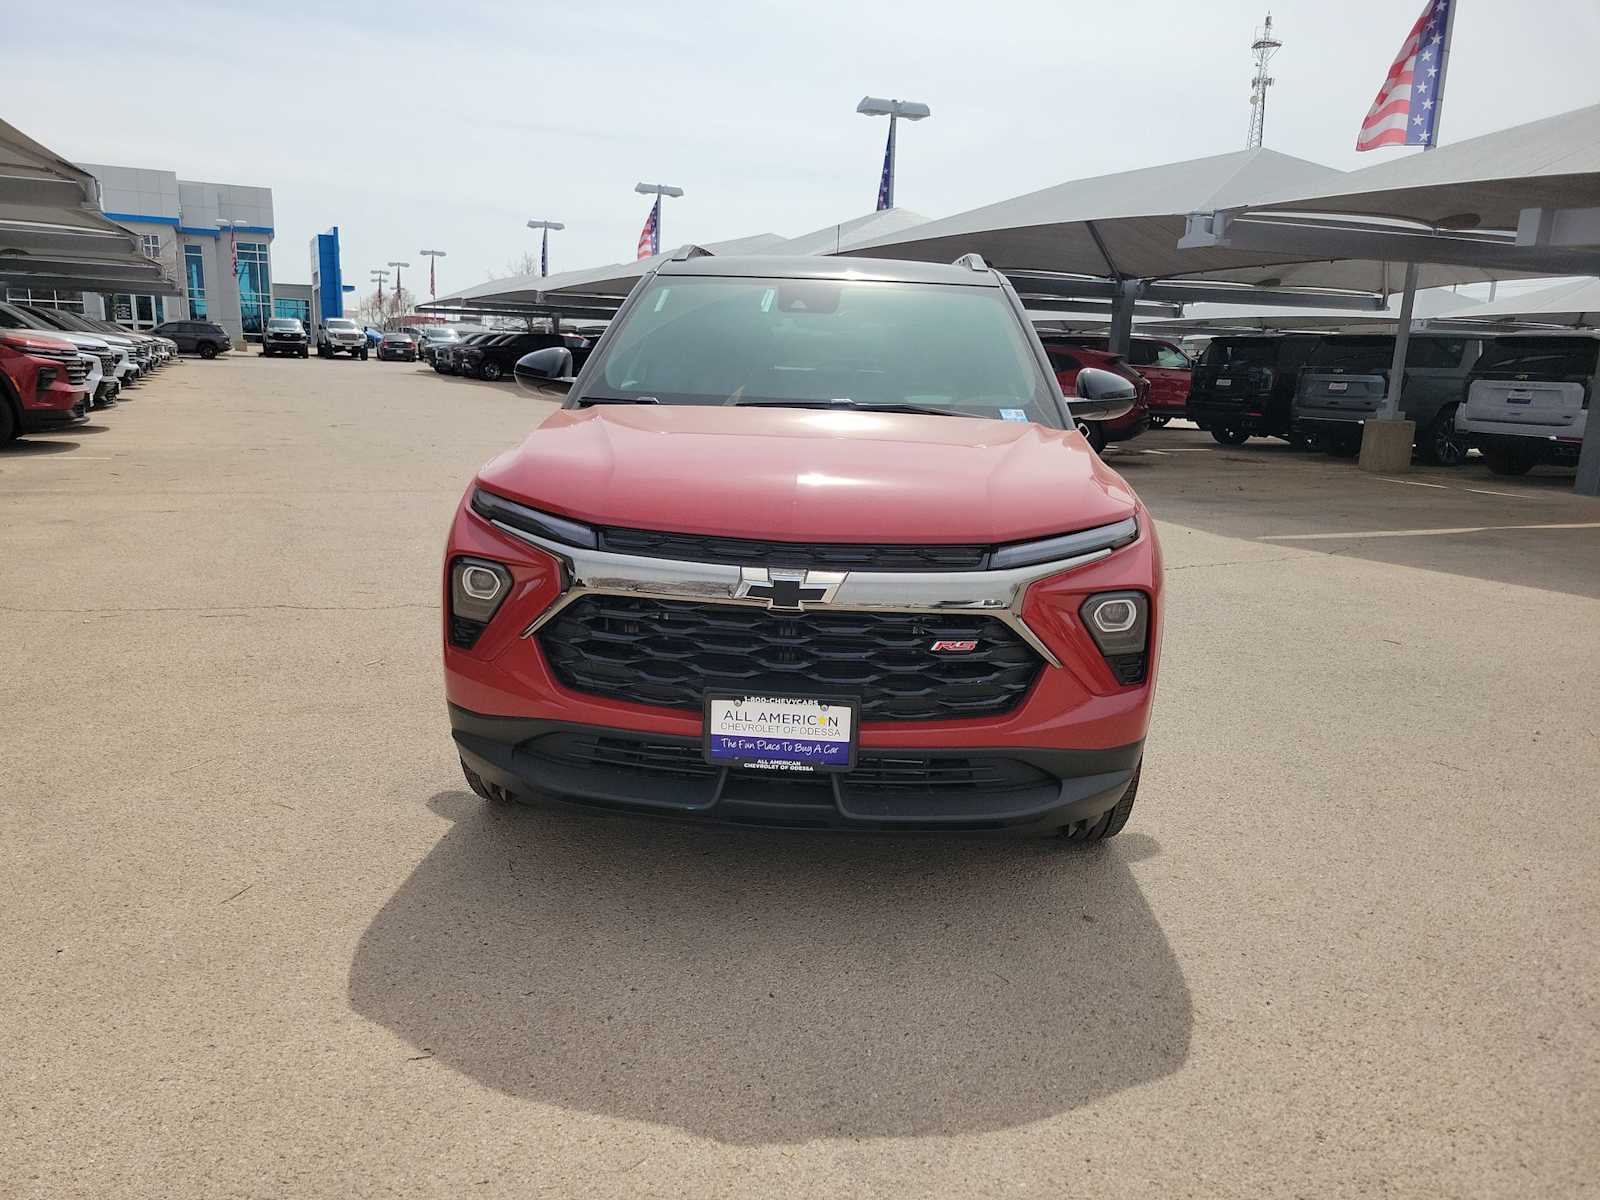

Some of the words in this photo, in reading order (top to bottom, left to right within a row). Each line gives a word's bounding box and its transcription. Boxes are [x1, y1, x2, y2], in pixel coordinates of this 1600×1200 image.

[931, 640, 978, 651] RS
[723, 710, 752, 722] ALL
[758, 712, 838, 727] AMERICN
[720, 722, 781, 734] CHEVROLET
[783, 725, 798, 735] OF
[799, 727, 841, 737] ODESSA
[721, 738, 737, 749] The
[738, 740, 756, 750] Fun
[757, 740, 781, 751] Place
[782, 741, 793, 752] To
[813, 745, 822, 754] A
[823, 745, 840, 754] Car
